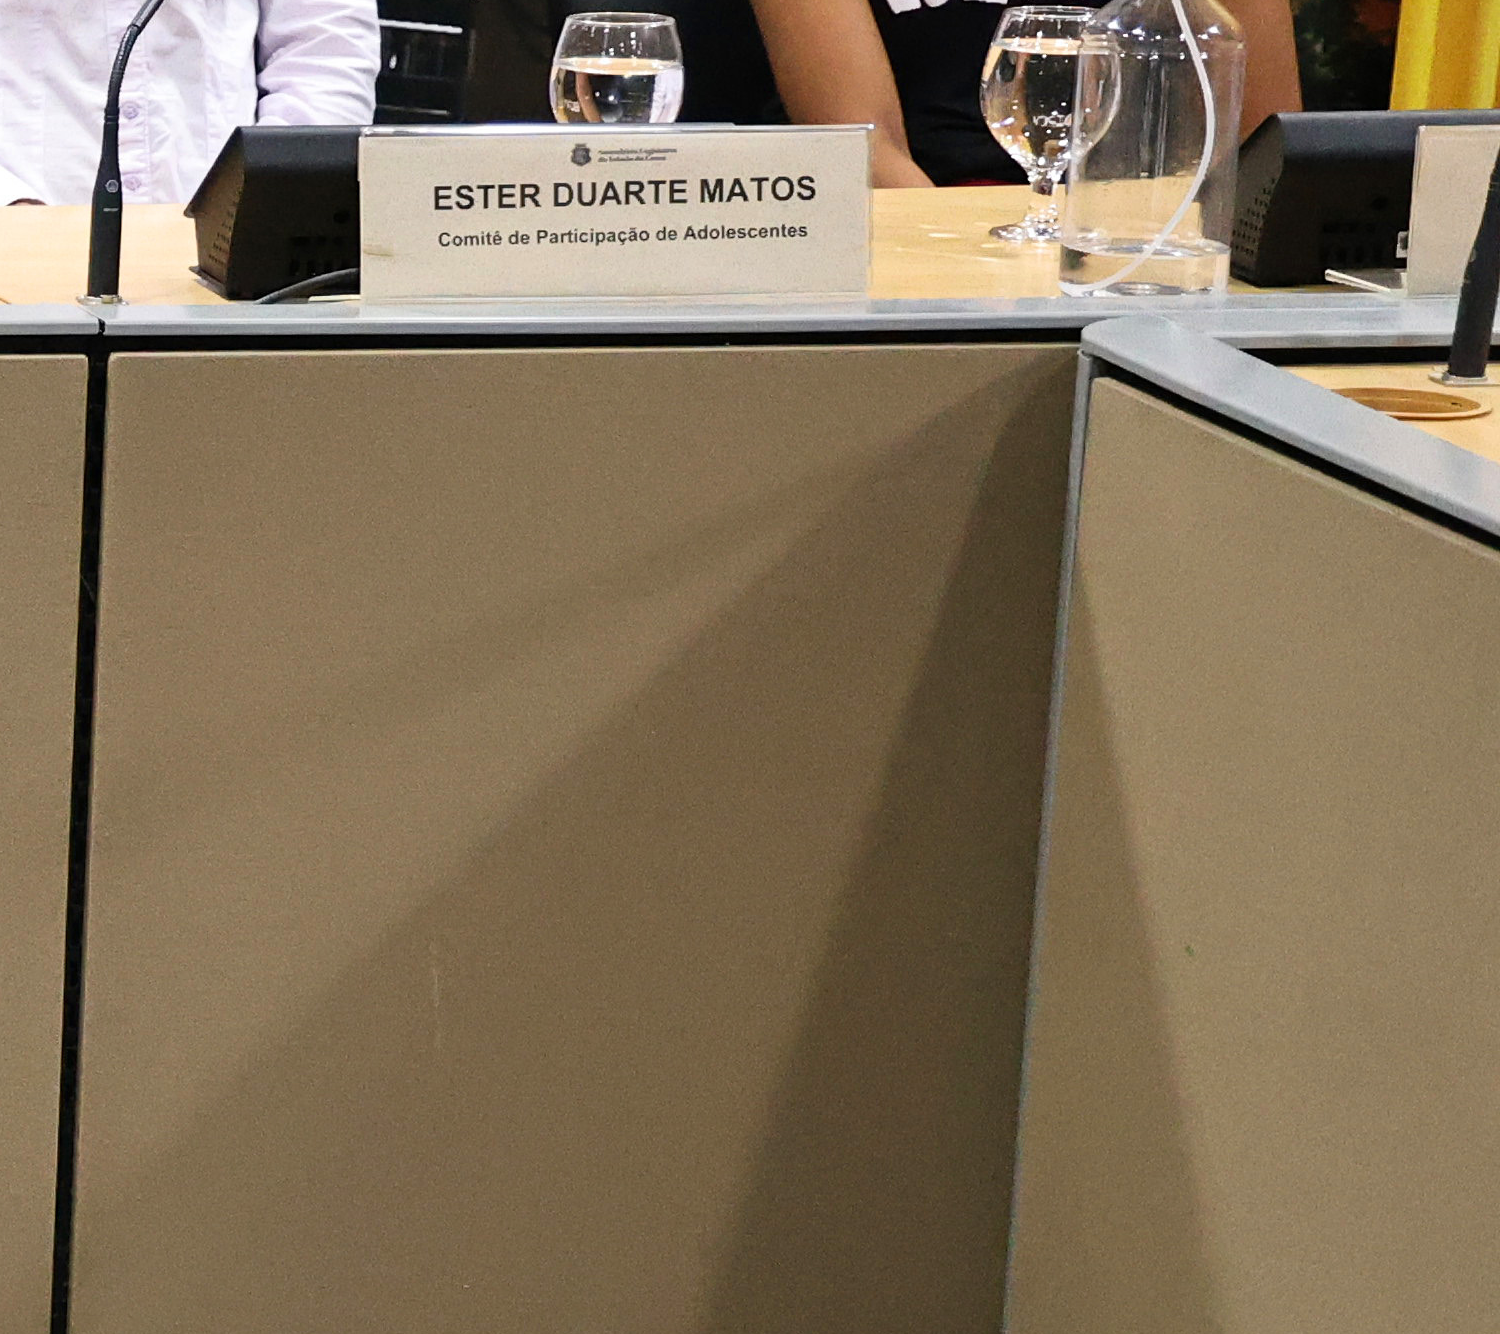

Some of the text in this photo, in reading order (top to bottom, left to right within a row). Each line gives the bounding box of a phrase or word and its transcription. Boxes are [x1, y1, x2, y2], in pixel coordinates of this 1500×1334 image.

[433, 175, 816, 211] ESTER DUARTE MATOS
[438, 223, 808, 248] Comitê de Participação de Adolescentes
